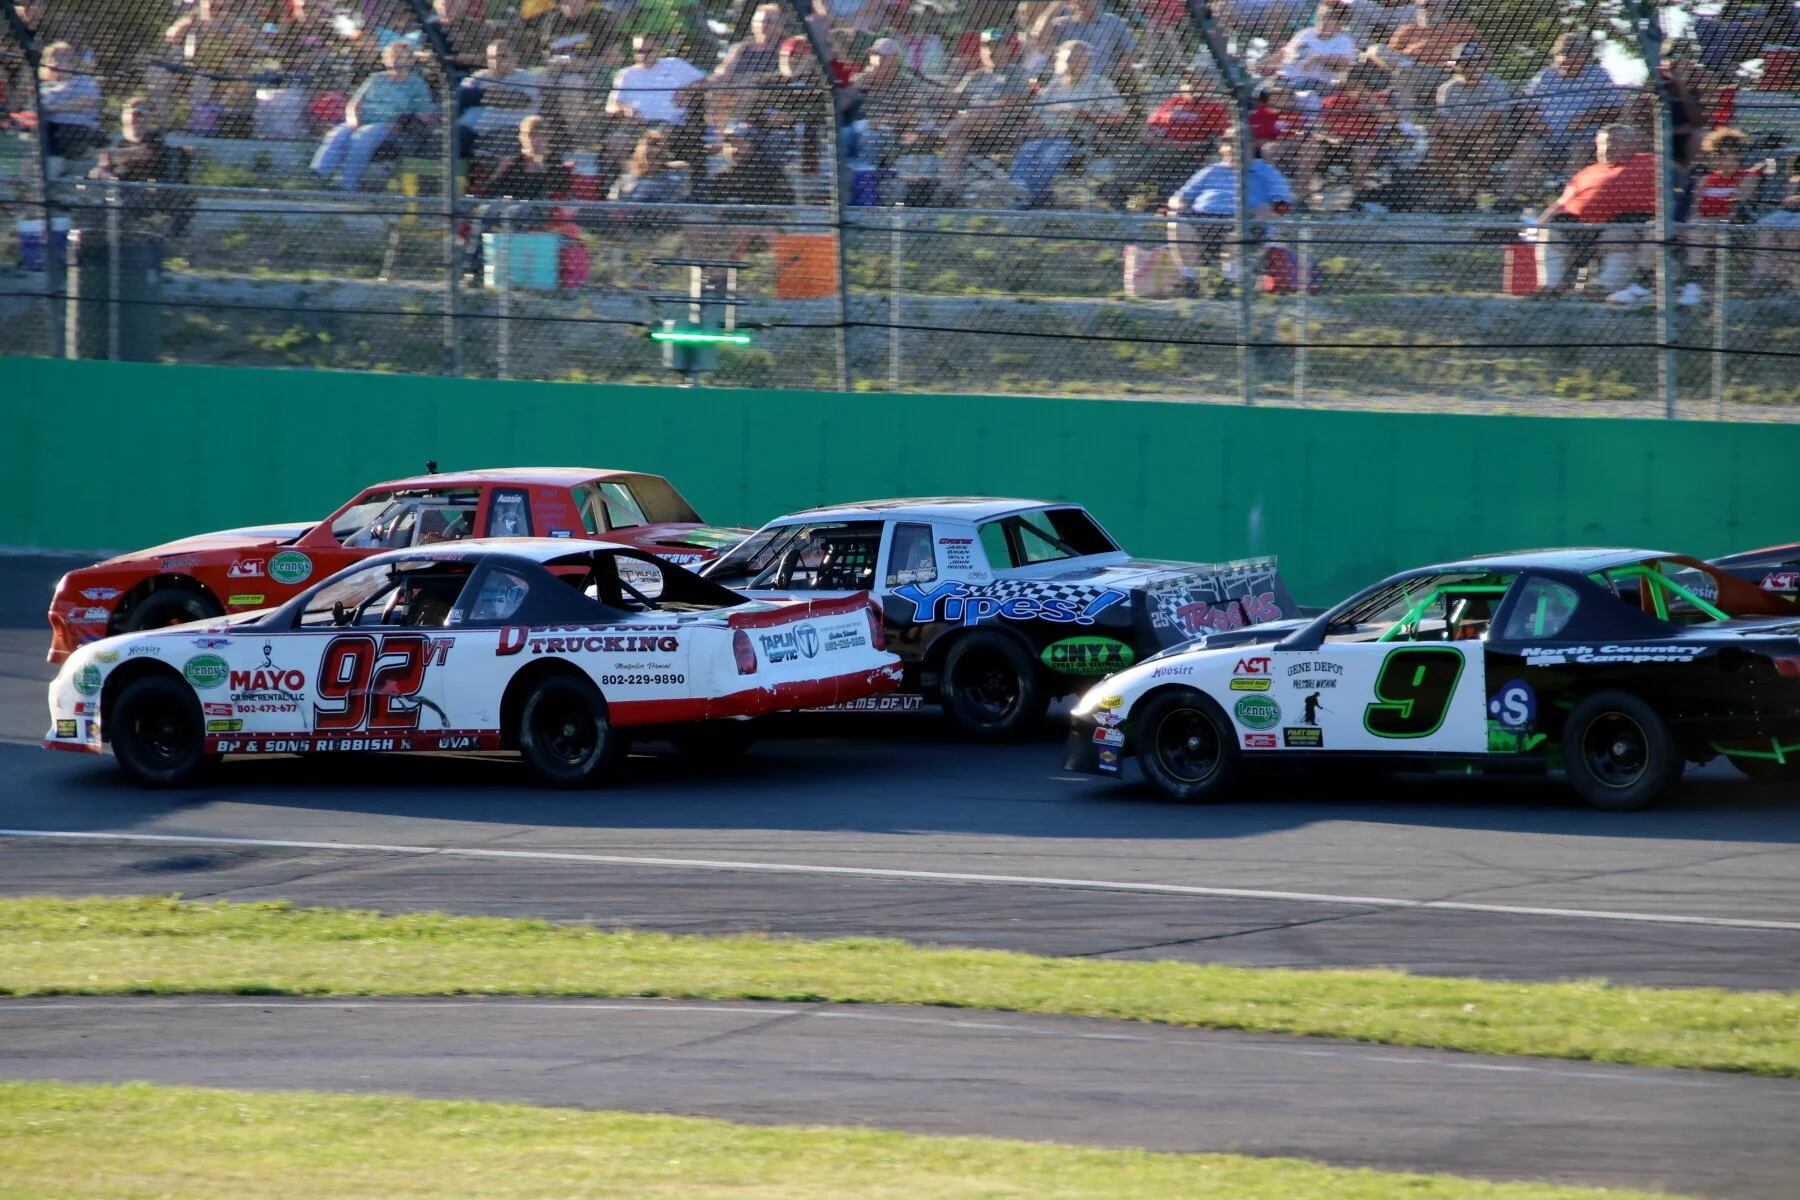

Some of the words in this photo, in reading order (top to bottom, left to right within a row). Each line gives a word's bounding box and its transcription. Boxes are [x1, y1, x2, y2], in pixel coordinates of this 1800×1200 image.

[497, 494, 522, 503] Aussie
[227, 559, 264, 577] ACT
[272, 560, 311, 575] Lenny's
[891, 580, 1127, 627] Yipes!
[1151, 611, 1170, 628] 25
[128, 645, 161, 655] Hoosier
[421, 637, 455, 666] VT
[528, 636, 679, 653] TRUCKING
[759, 631, 798, 656] TAPLIN
[1521, 646, 1594, 657] North
[1600, 644, 1708, 655] Country
[769, 649, 798, 663] SEPTIC
[1051, 644, 1125, 662] ONYX
[1576, 654, 1694, 664] Campers
[187, 663, 226, 679] Lenny's
[647, 662, 671, 670] Vermont
[1151, 664, 1194, 678] Hoosier
[1233, 657, 1272, 674] ACT
[1287, 662, 1312, 676] GENE
[1314, 661, 1344, 676] DEPOT
[229, 670, 305, 691] MAYO
[313, 633, 431, 732] 92
[602, 674, 685, 684] 802-229-9890
[290, 693, 305, 701] LLC
[1363, 645, 1466, 739] 9
[881, 698, 900, 709] OF
[903, 696, 924, 709] VT
[1238, 702, 1280, 719] Lenny's
[1502, 687, 1530, 726] S
[216, 740, 241, 752] BP
[246, 740, 258, 752] &
[264, 740, 310, 752] SONS
